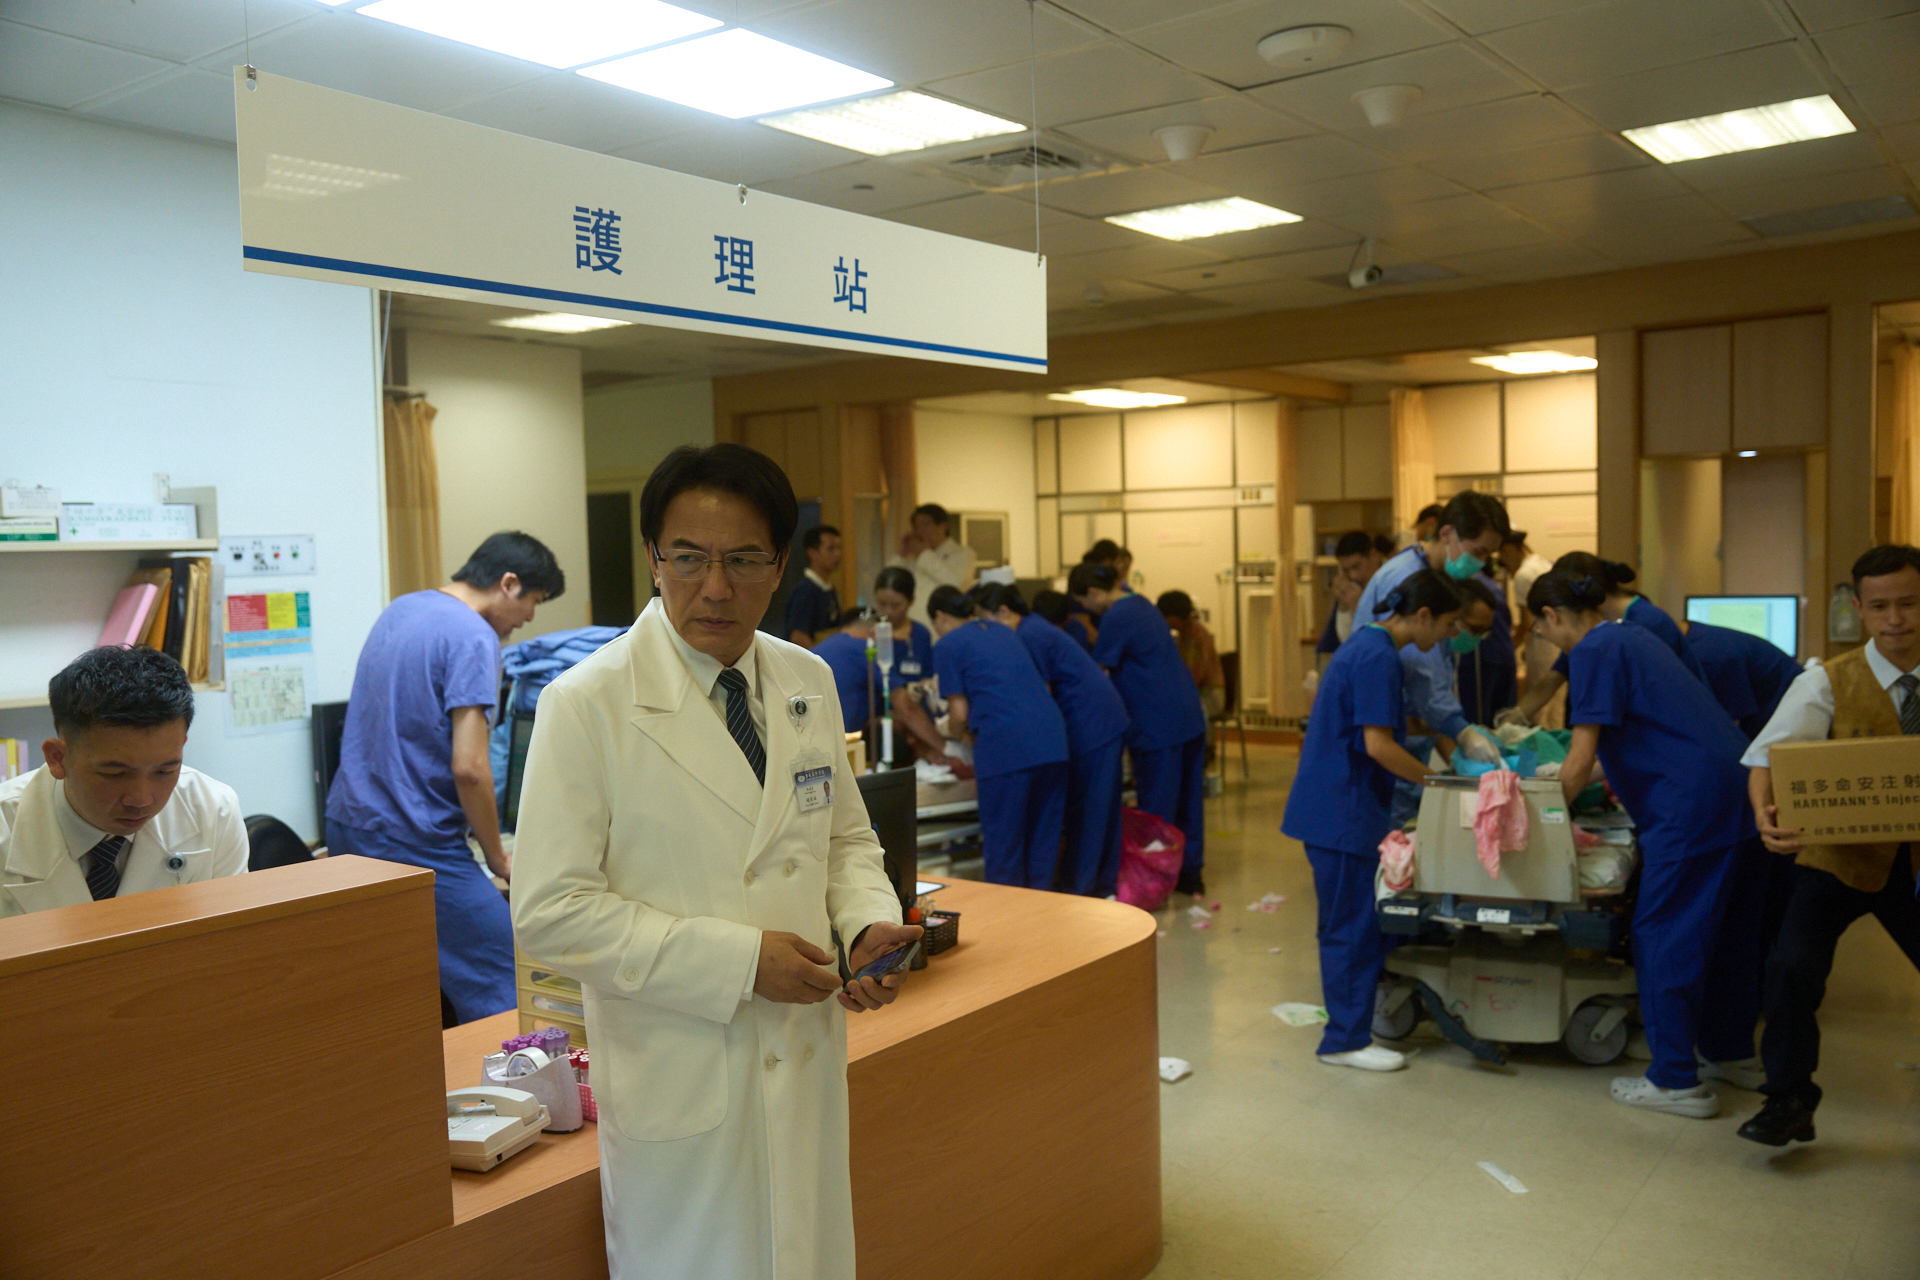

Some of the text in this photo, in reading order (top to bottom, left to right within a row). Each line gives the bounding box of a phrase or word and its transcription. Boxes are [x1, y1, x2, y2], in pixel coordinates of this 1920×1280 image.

[573, 205, 868, 314] 護理站
[1793, 795, 1880, 810] HARTMANN'S
